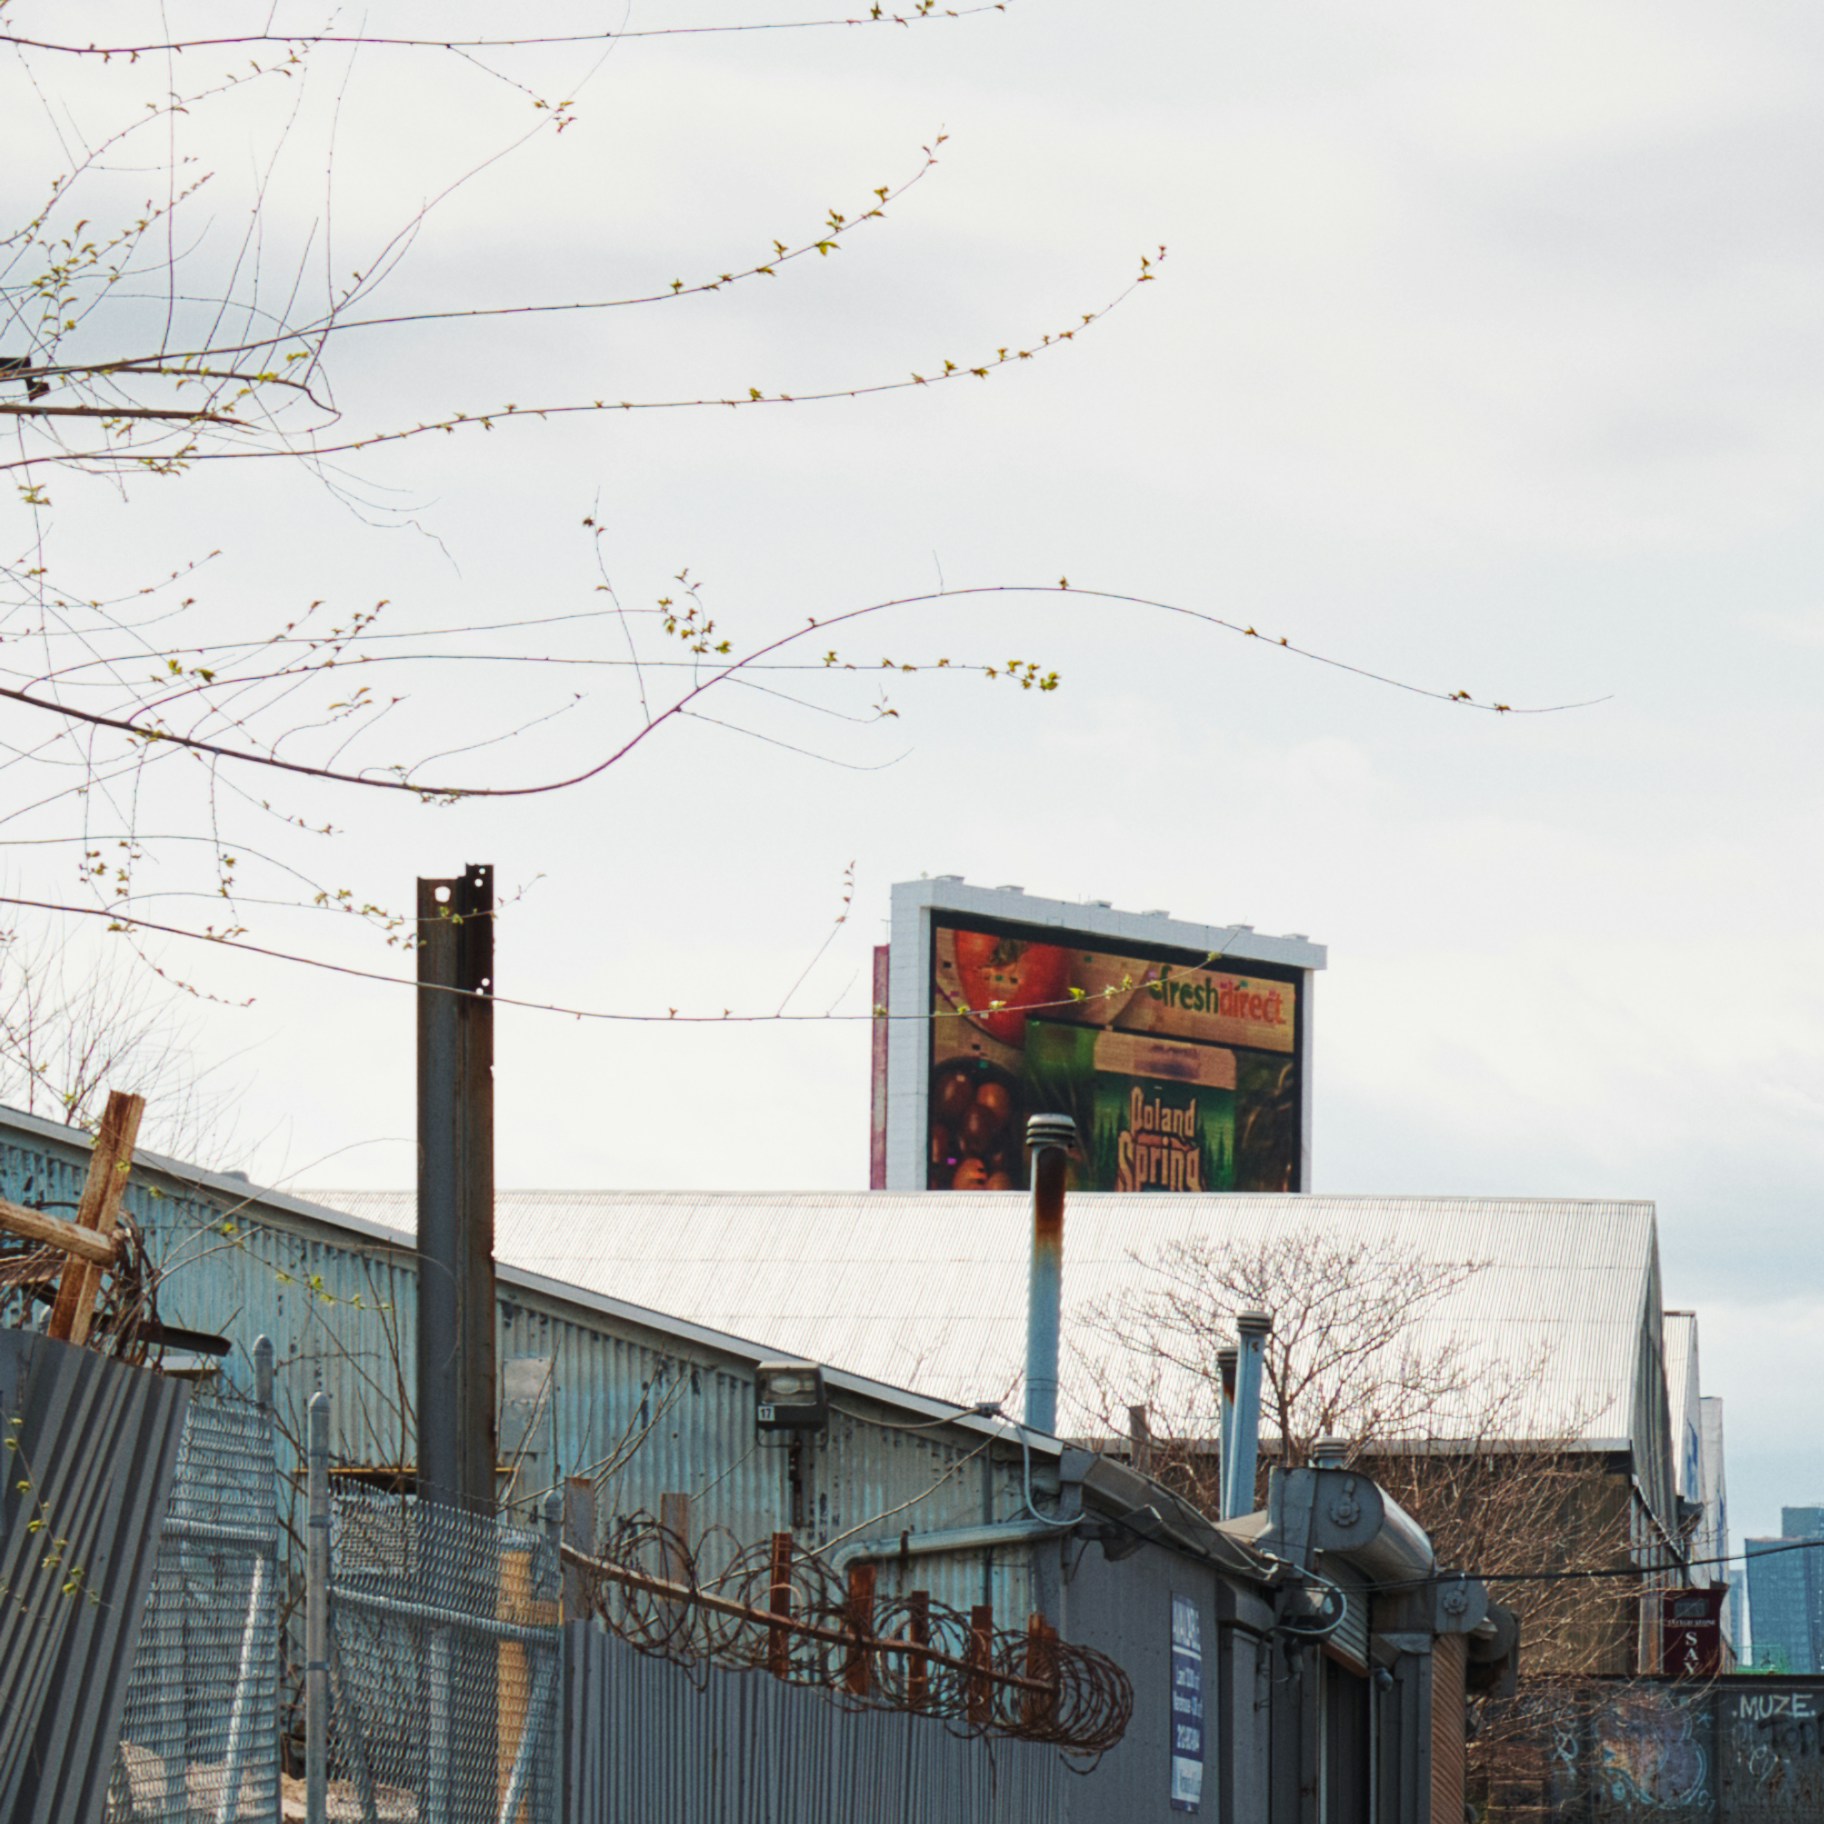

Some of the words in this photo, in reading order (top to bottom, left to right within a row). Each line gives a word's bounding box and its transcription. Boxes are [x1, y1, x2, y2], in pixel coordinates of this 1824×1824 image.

[1149, 964, 1287, 1024] freshdirect
[1130, 1086, 1196, 1138] Poland
[1116, 1130, 1202, 1192] Spring
